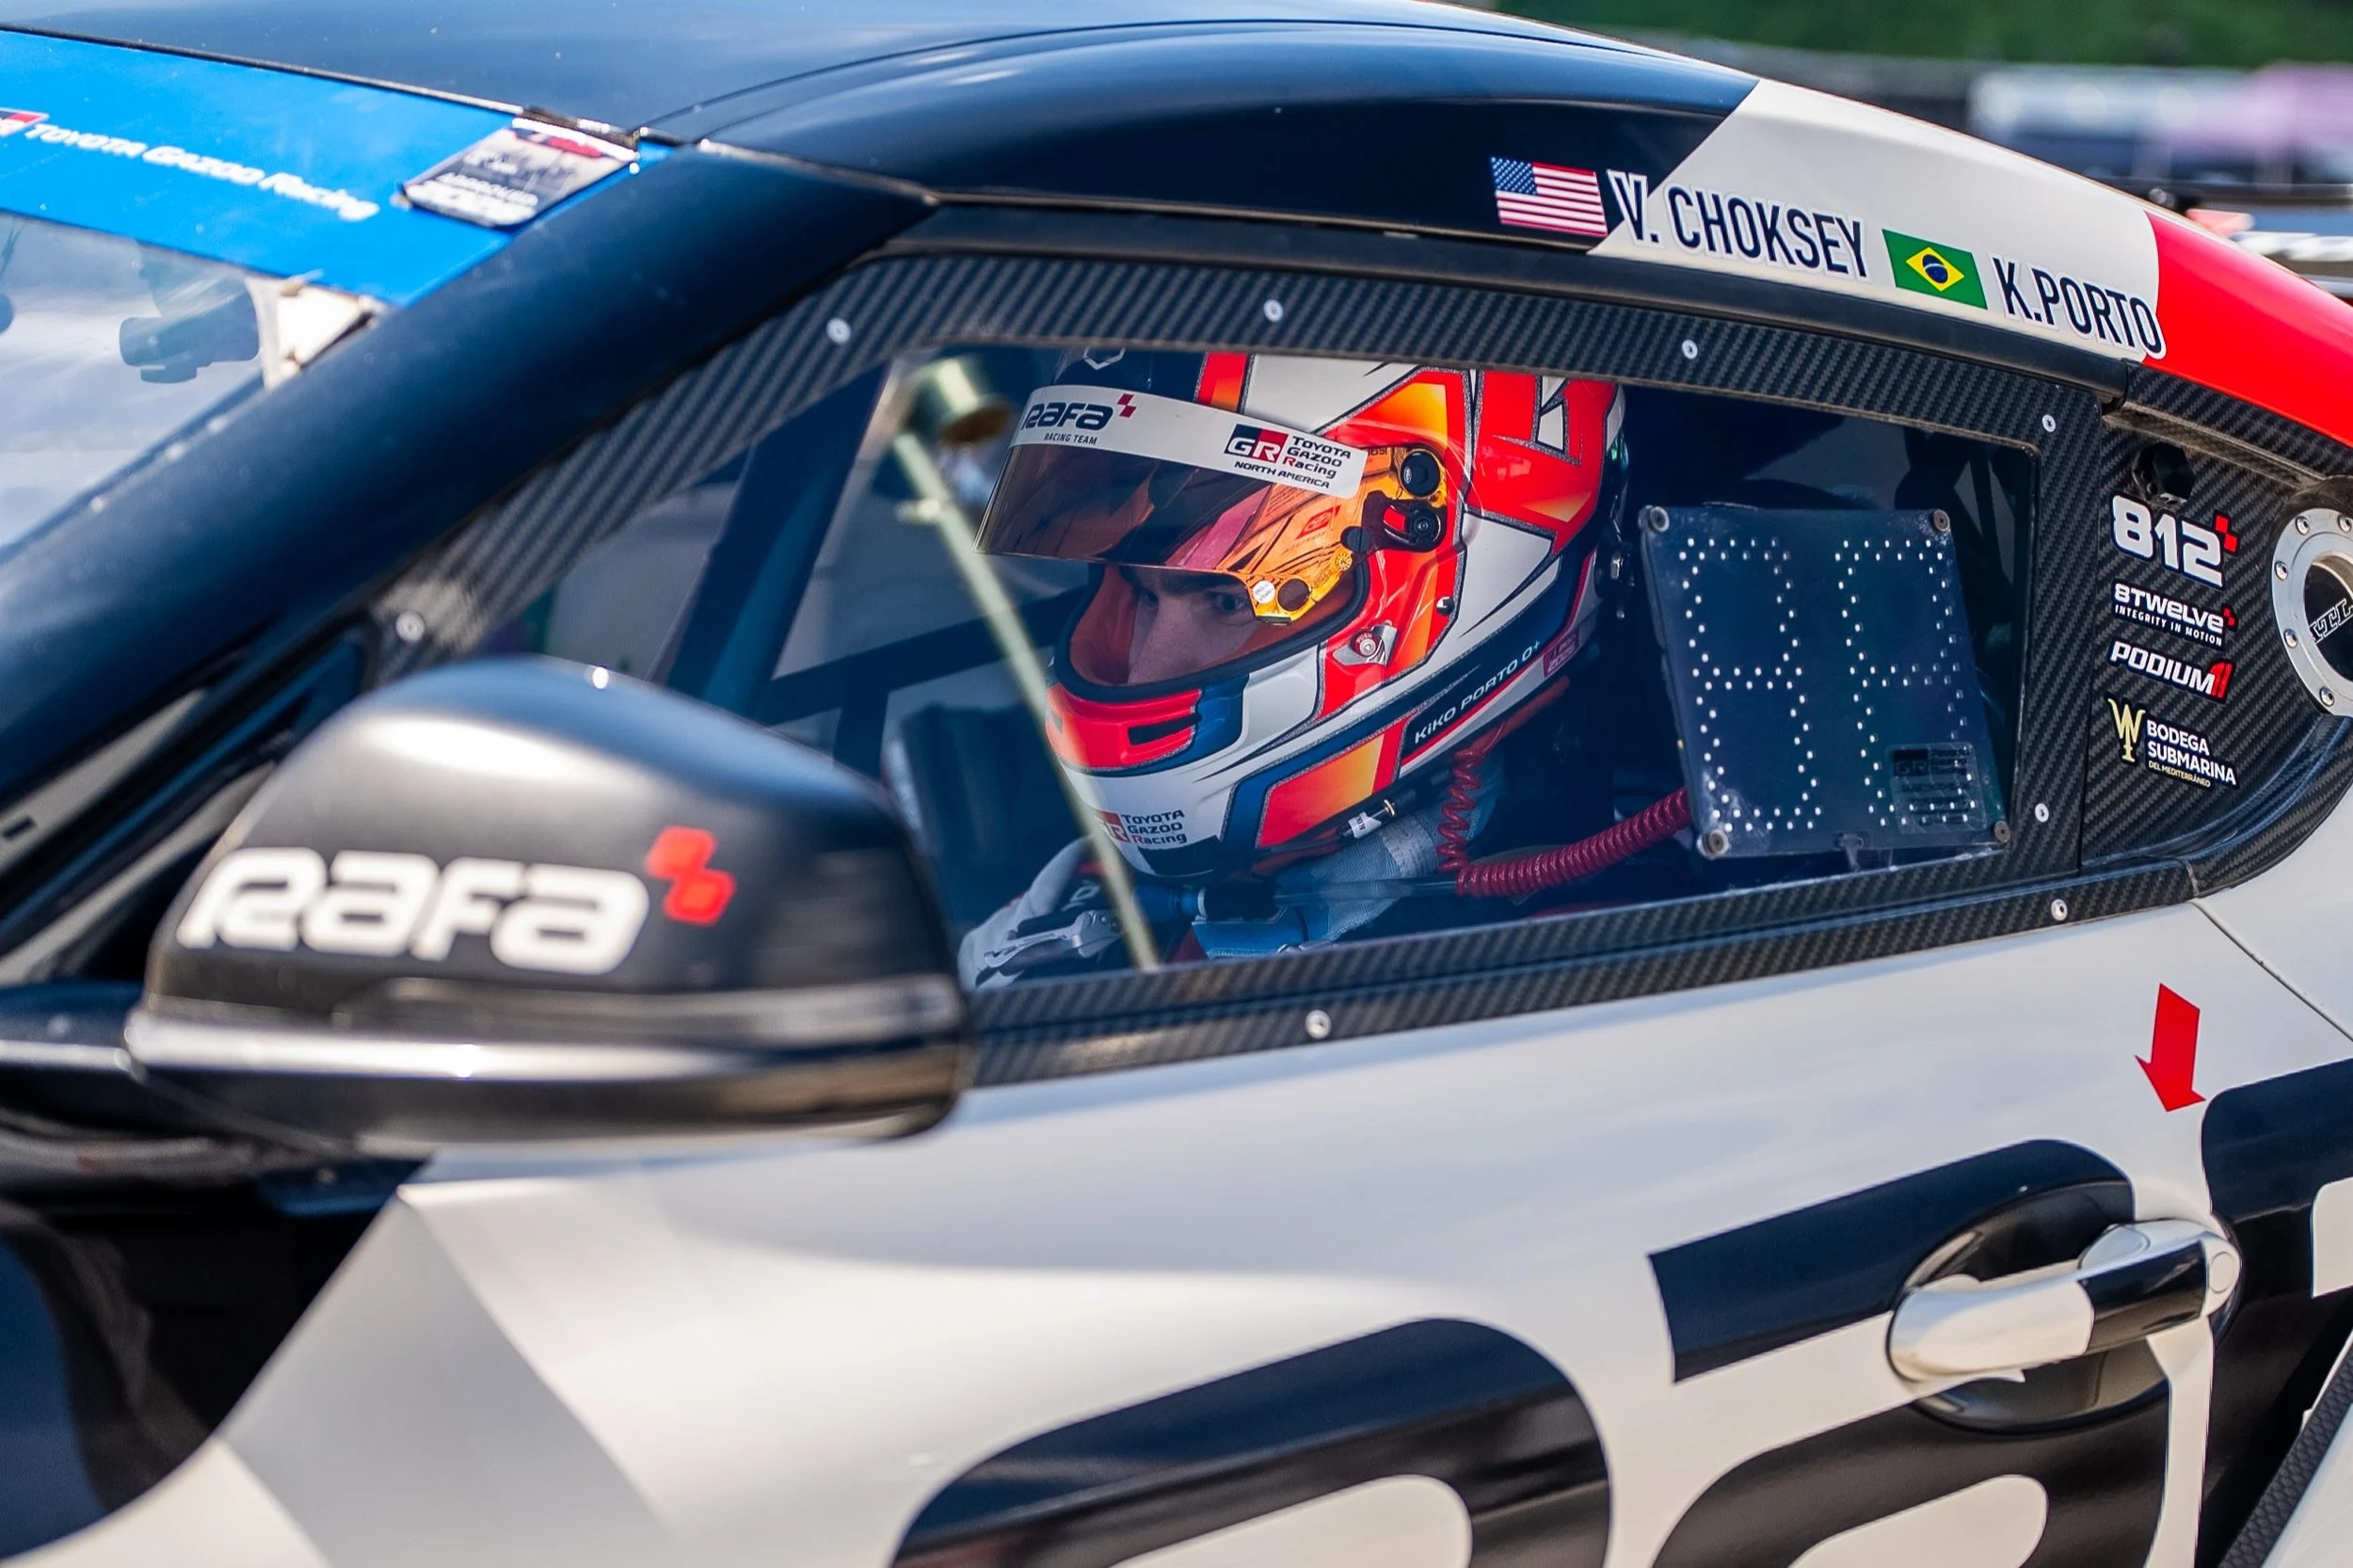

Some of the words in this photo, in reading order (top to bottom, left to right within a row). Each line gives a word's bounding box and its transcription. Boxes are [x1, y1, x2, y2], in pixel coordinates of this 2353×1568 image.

[1607, 170, 1659, 245] V.
[1670, 186, 1867, 279] CHOKSEY
[1991, 256, 2163, 355] K.PORTO
[1044, 433, 1072, 442] RACING
[1073, 435, 1097, 445] TEAM
[1292, 435, 1352, 459] TOYOTA
[1282, 456, 1337, 479] Racing
[1287, 446, 1342, 468] GAZOO
[1235, 460, 1277, 475] NORTH
[1277, 470, 1330, 489] AMERICA
[2113, 495, 2222, 587] 812
[2115, 604, 2167, 627] INTEGRITY
[2171, 619, 2181, 632] IN
[2185, 624, 2222, 647] MOTION
[1461, 658, 1518, 710] PORTO
[2146, 719, 2210, 755] BODEGA
[2147, 741, 2236, 785] SUBMARINA
[2148, 760, 2161, 771] DEL
[1121, 809, 1185, 824] TOYOTA
[1128, 822, 1183, 835] GAZOO
[1132, 832, 1187, 845] Racing
